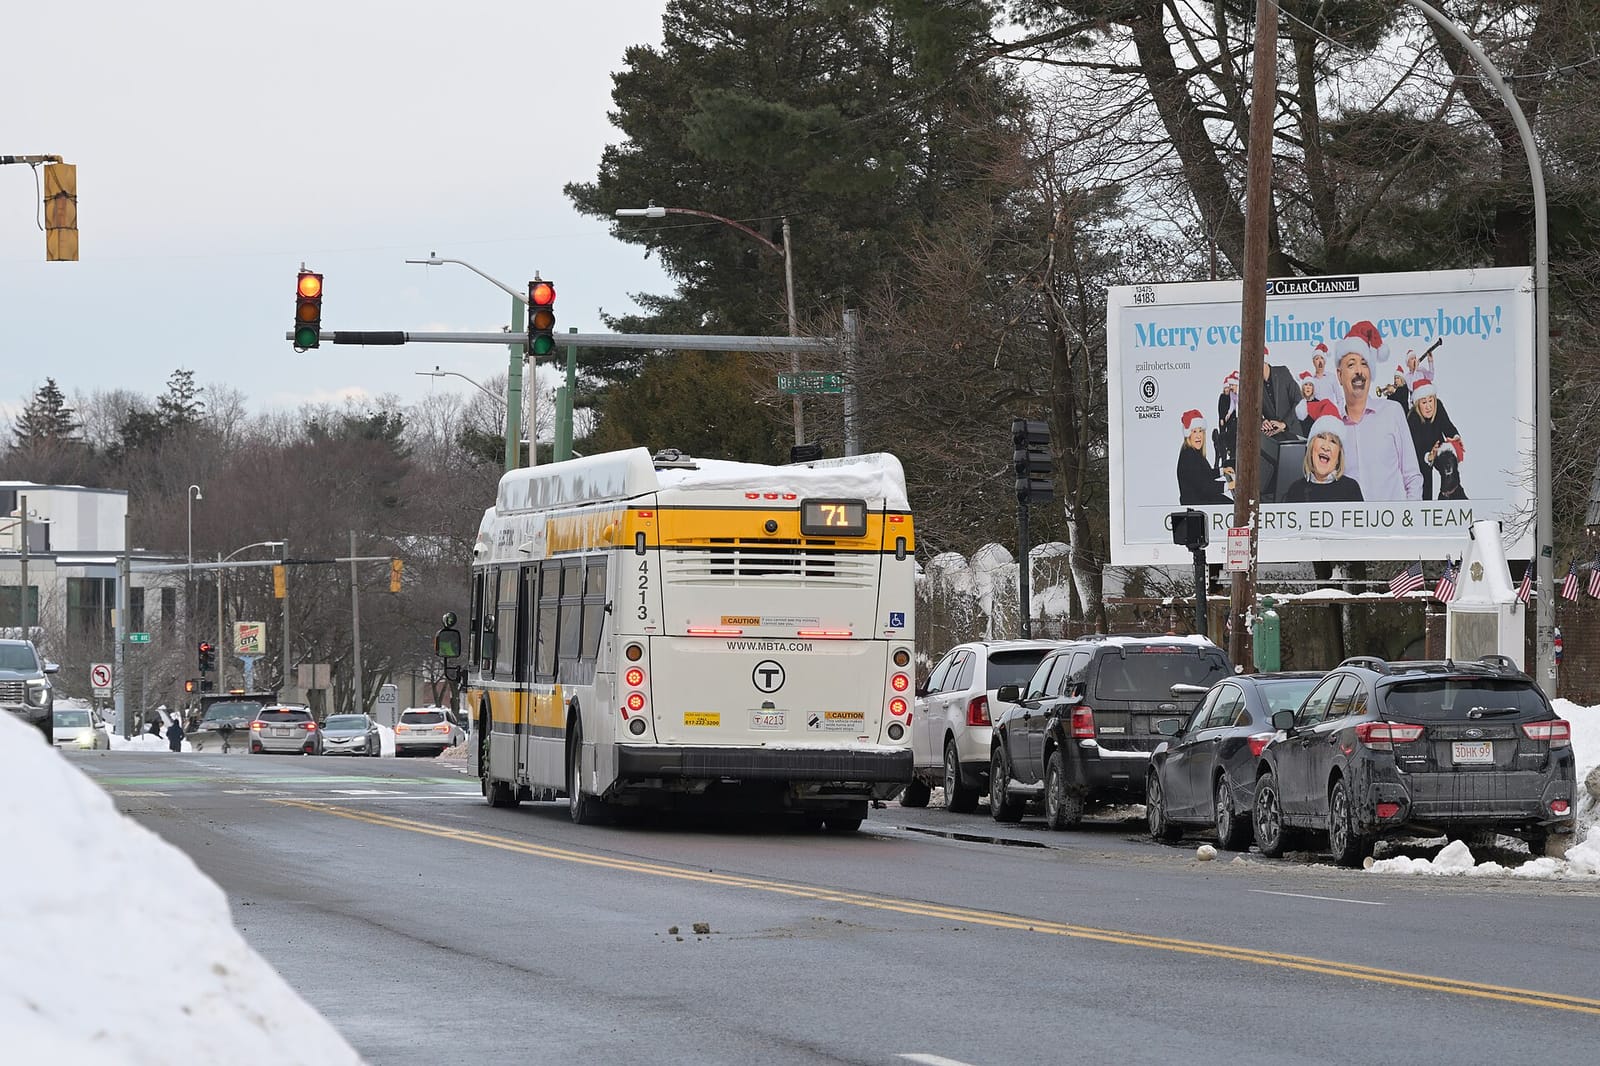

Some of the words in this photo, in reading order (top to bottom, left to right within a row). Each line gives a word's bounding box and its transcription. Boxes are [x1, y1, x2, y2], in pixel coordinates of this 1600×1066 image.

[1133, 292, 1156, 304] 14183
[1135, 322, 1202, 352] Merry
[1206, 314, 1325, 347] evething
[1329, 316, 1350, 340] to
[1377, 306, 1502, 342] everybody!
[1136, 361, 1191, 373] gailroberts.com
[820, 505, 848, 526] 71
[1213, 512, 1302, 530] RORTS,
[1310, 510, 1334, 528] ED
[1342, 510, 1394, 528] FEIJO
[1402, 510, 1414, 528] &
[1421, 508, 1473, 526] TEAM
[638, 560, 649, 620] 4213
[726, 642, 812, 652] WWW.MBTA.COM
[764, 716, 784, 725] 4213
[1456, 747, 1478, 758] 3DHK
[1480, 747, 1490, 757] 99
